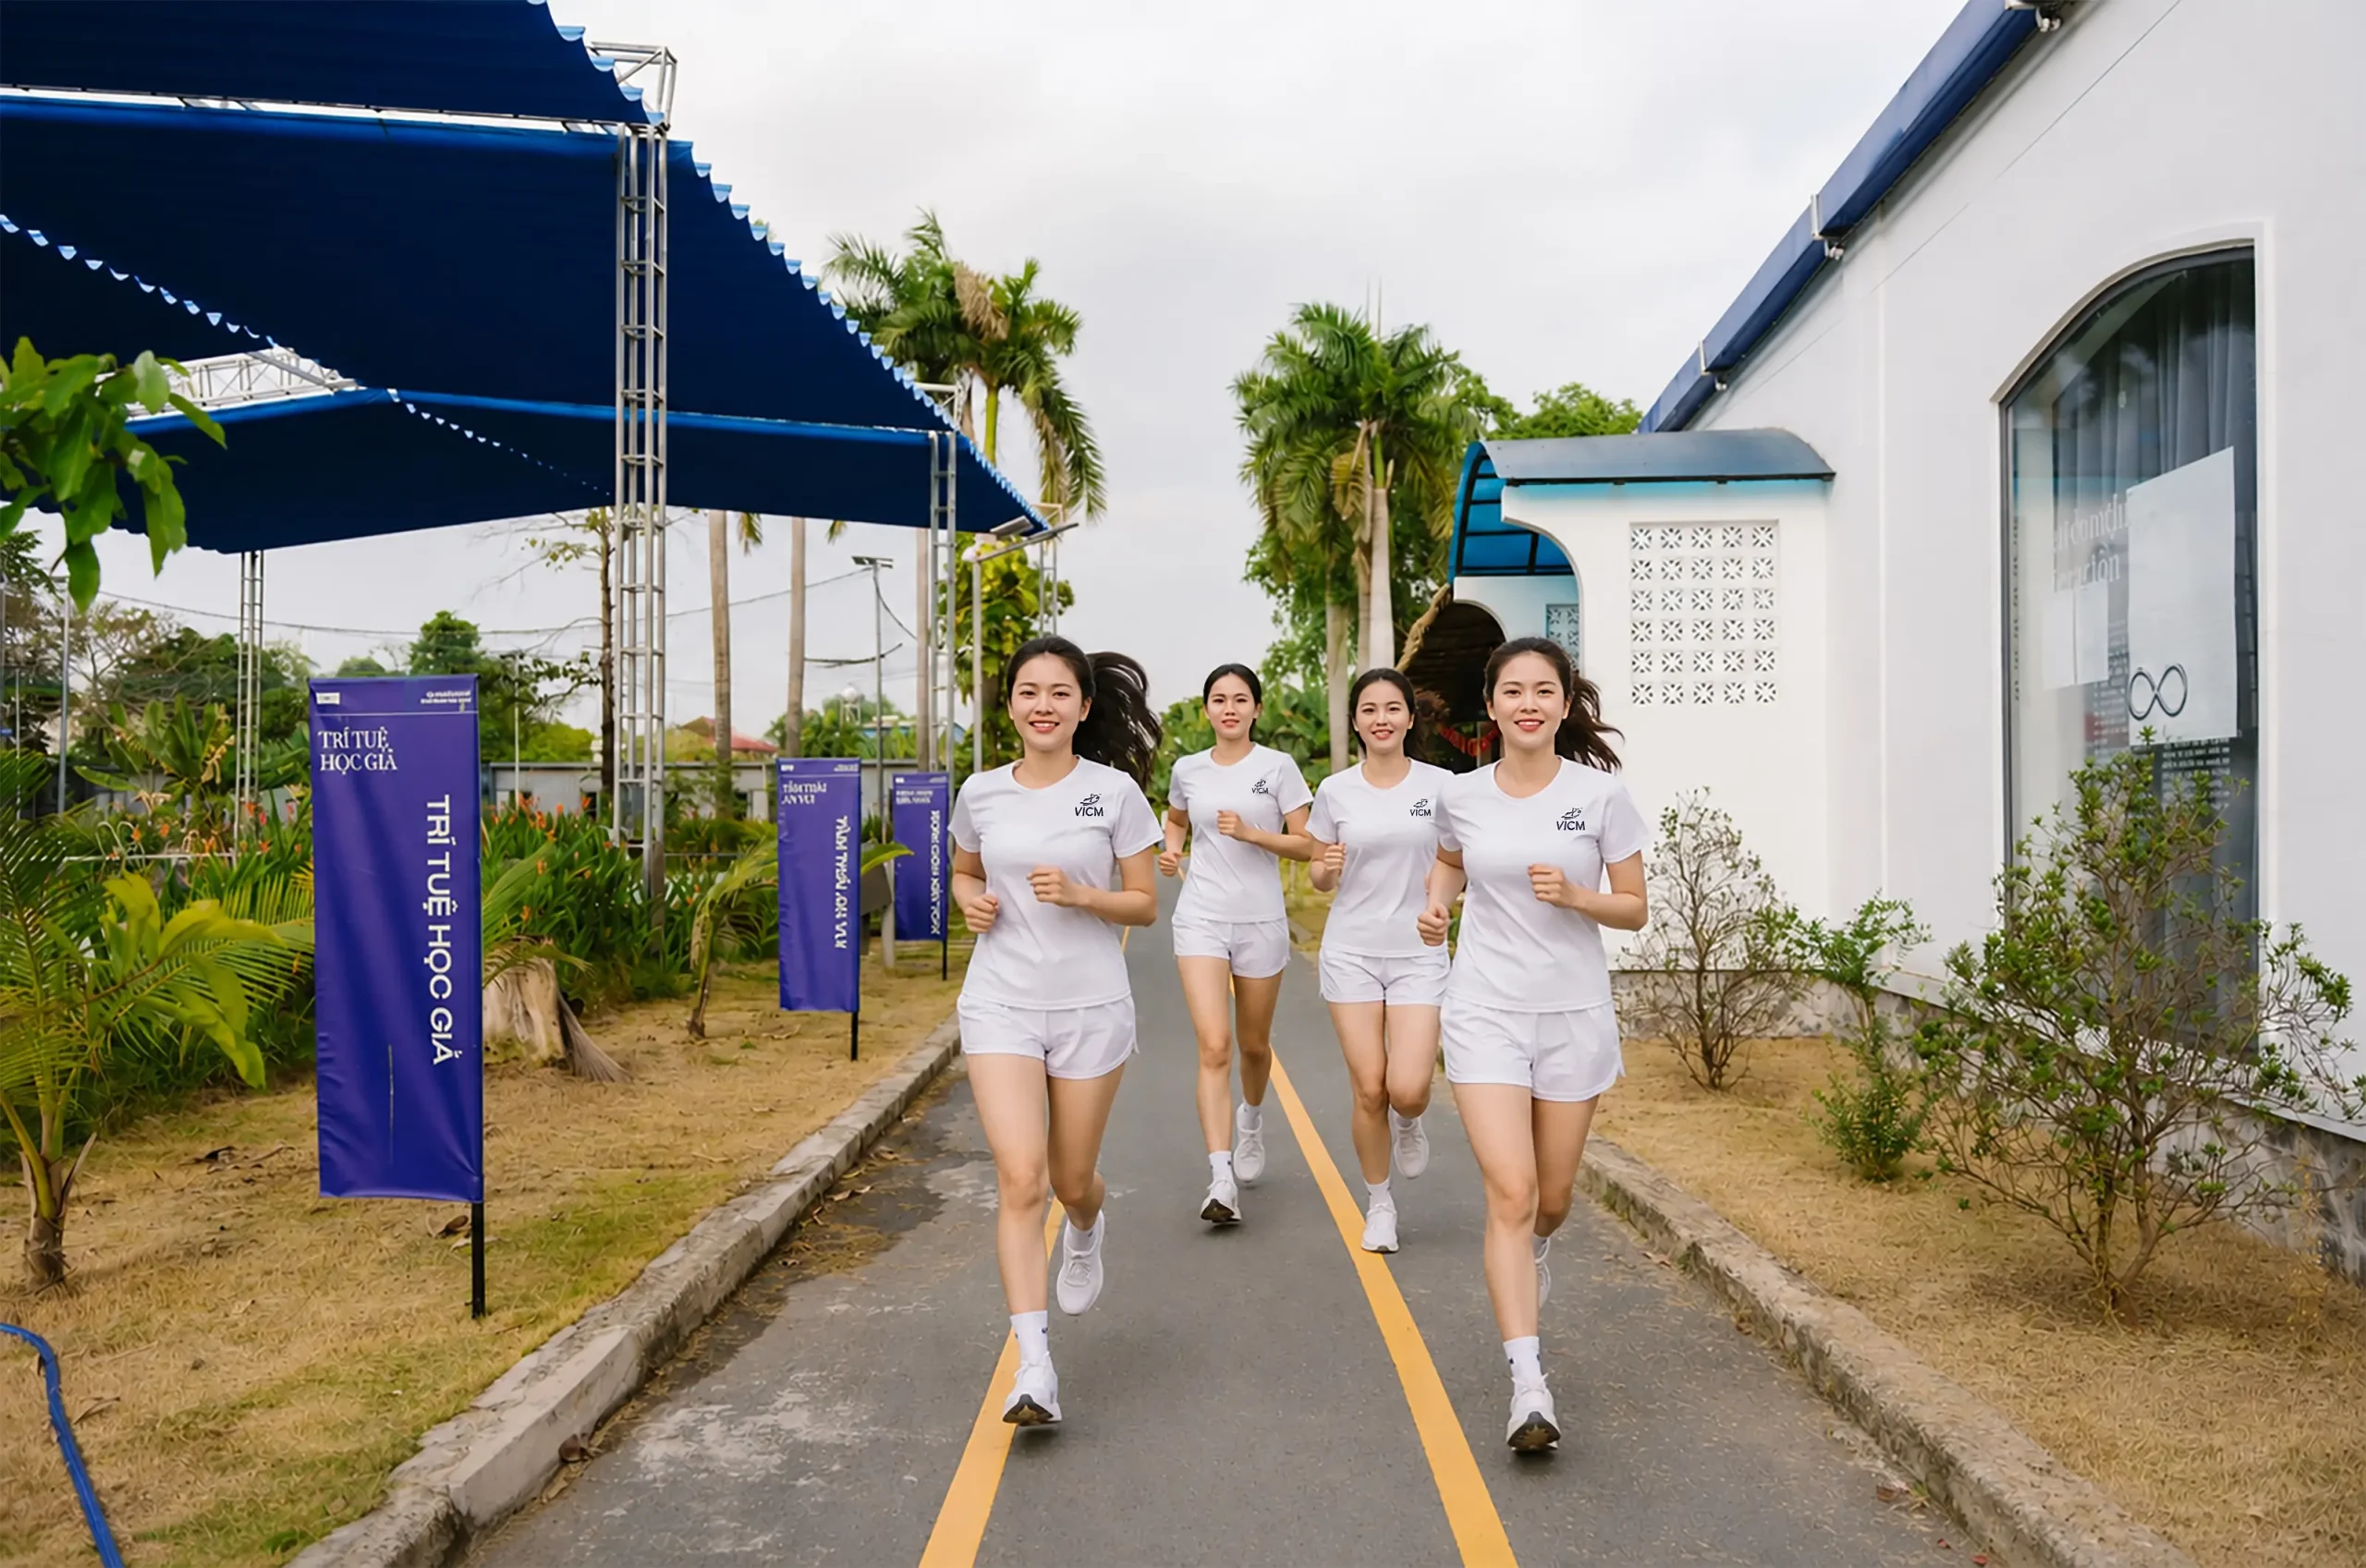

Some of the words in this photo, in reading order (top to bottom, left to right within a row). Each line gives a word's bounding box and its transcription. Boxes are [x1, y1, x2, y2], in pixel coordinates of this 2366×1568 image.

[317, 726, 349, 748] TRÍ
[320, 753, 362, 775] HỌC
[427, 794, 457, 846] TRÍ
[1074, 807, 1104, 817] VICM
[1409, 808, 1432, 817] VICM
[1555, 820, 1586, 831] VICM
[422, 851, 458, 917] TUỆ
[423, 924, 453, 1000] HỌC
